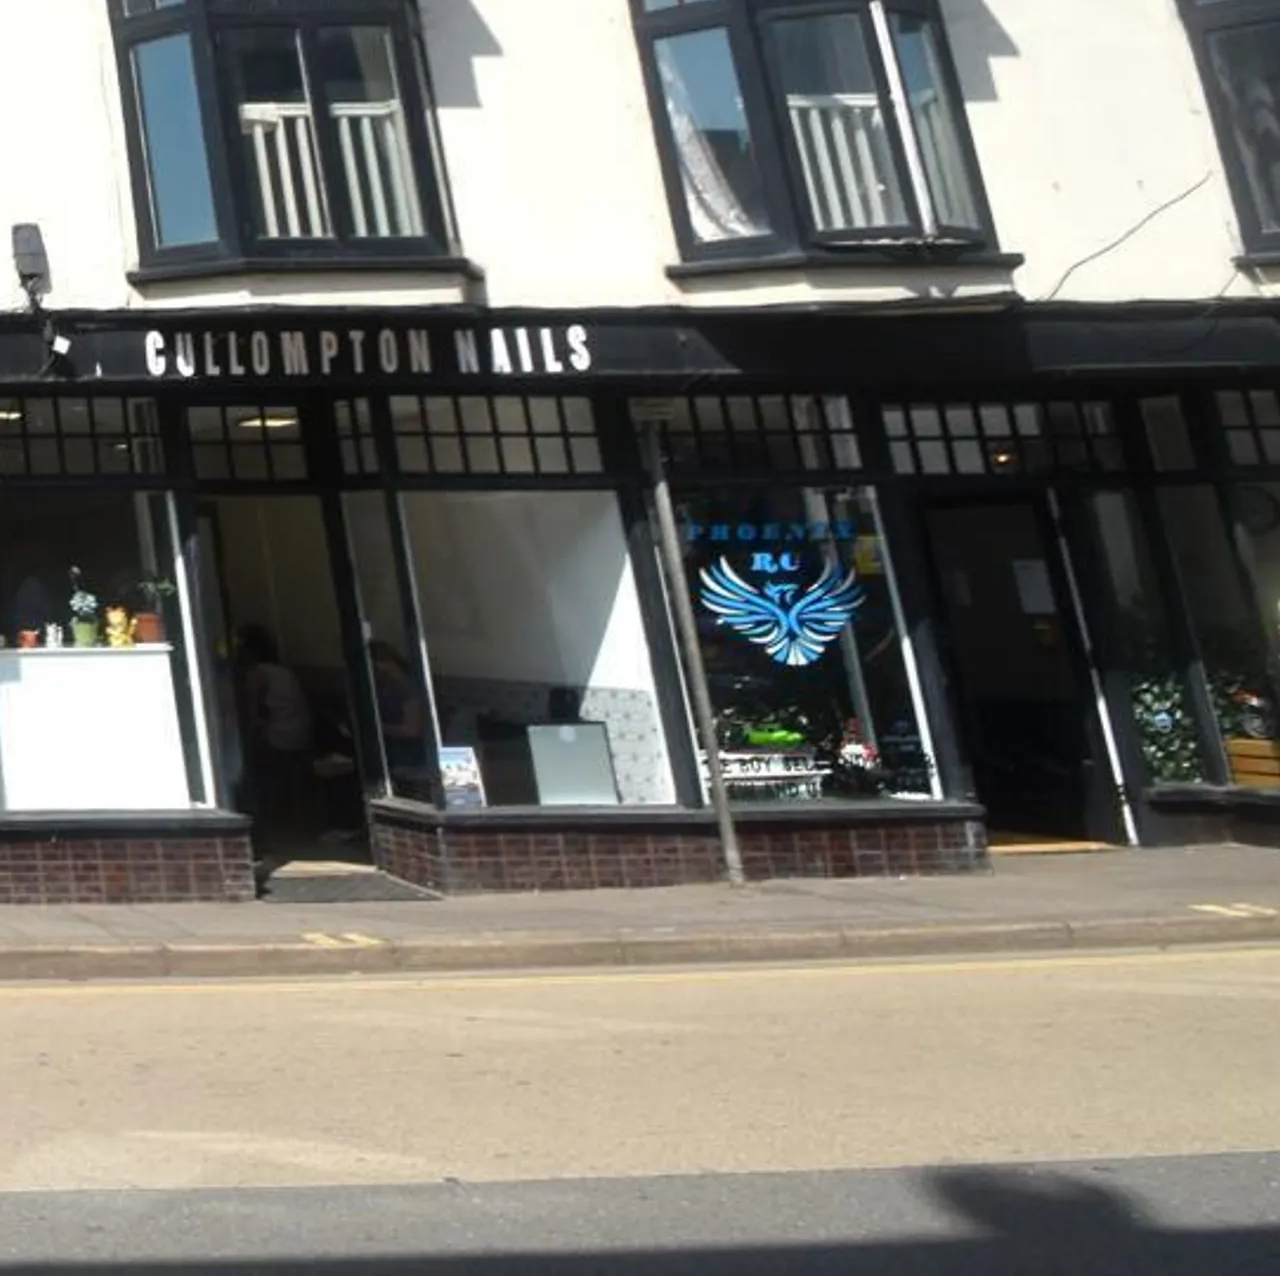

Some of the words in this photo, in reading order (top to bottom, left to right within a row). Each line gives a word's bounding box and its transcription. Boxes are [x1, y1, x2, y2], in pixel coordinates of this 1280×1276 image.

[144, 328, 433, 377] CULLOMPTON
[453, 324, 592, 375] NAILS
[686, 521, 856, 541] PHOENIX
